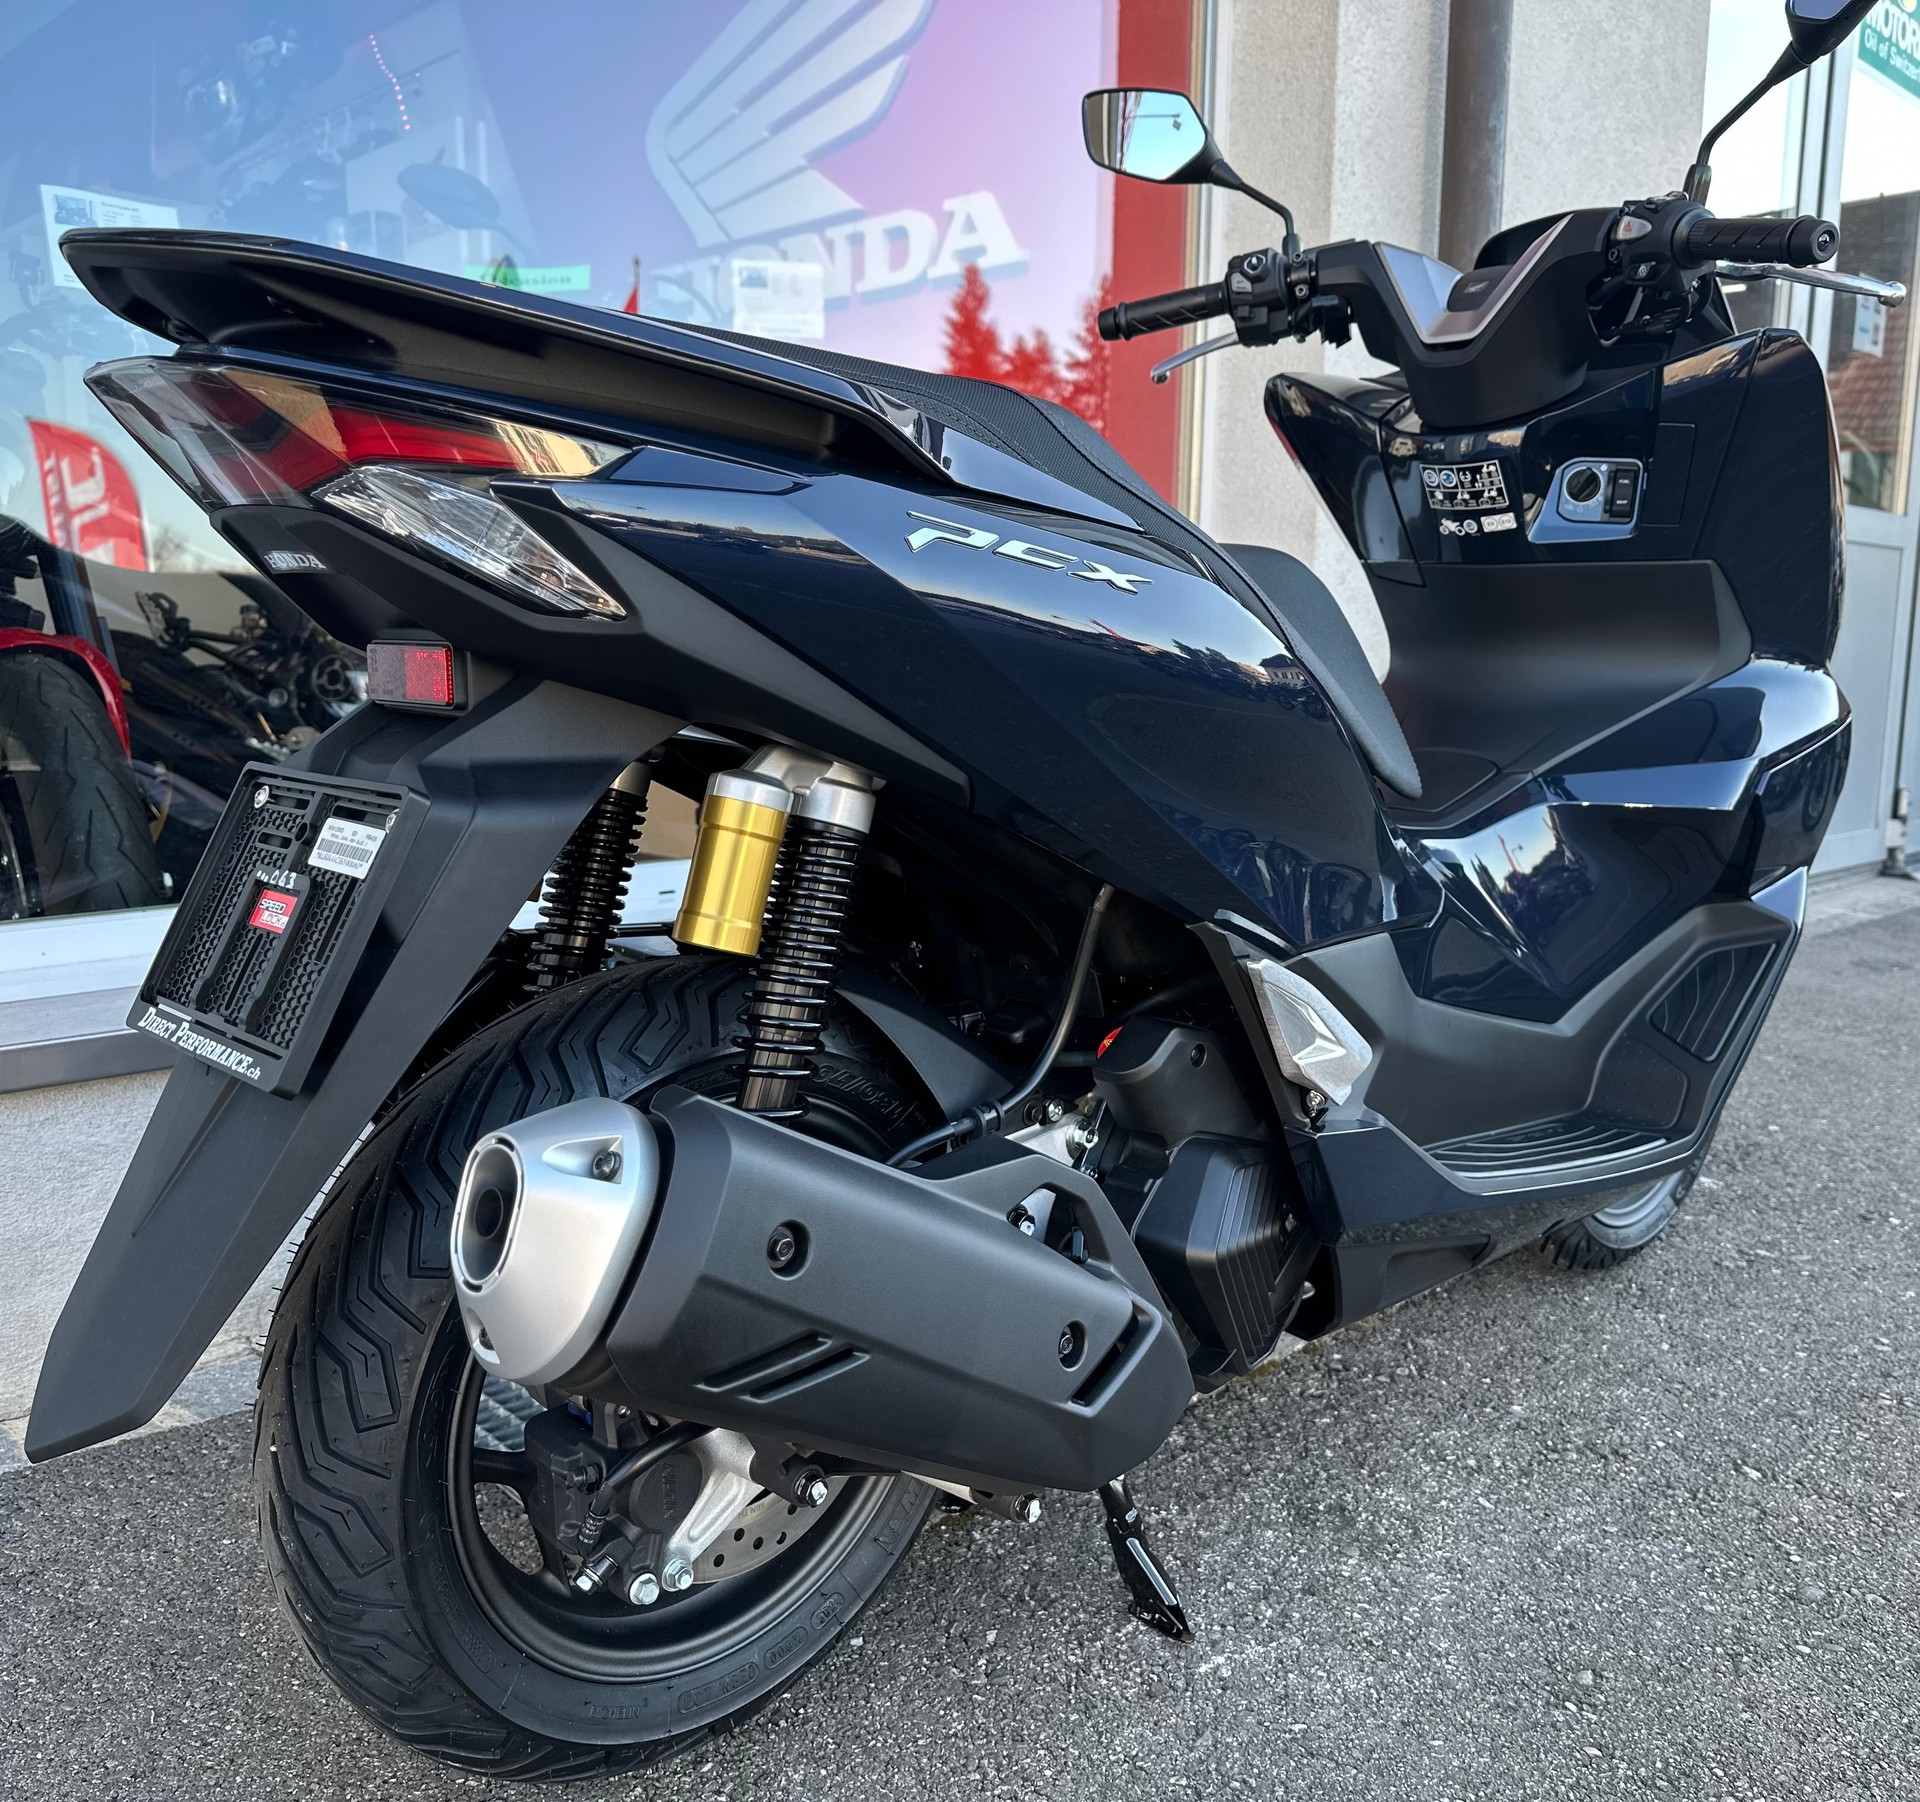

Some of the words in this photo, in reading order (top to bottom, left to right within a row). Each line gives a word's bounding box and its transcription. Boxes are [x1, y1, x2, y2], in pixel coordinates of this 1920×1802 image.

[1864, 0, 1920, 62] MOTOR
[1864, 28, 1877, 53] Oil
[1878, 41, 1889, 60] of
[264, 552, 327, 569] HONDA
[904, 510, 1154, 596] PCX
[259, 898, 287, 915] SPEED
[137, 1006, 177, 1039] DIRECT
[170, 1021, 262, 1081] PERFORMANCE.ch
[588, 1705, 642, 1721] MICHELIN
